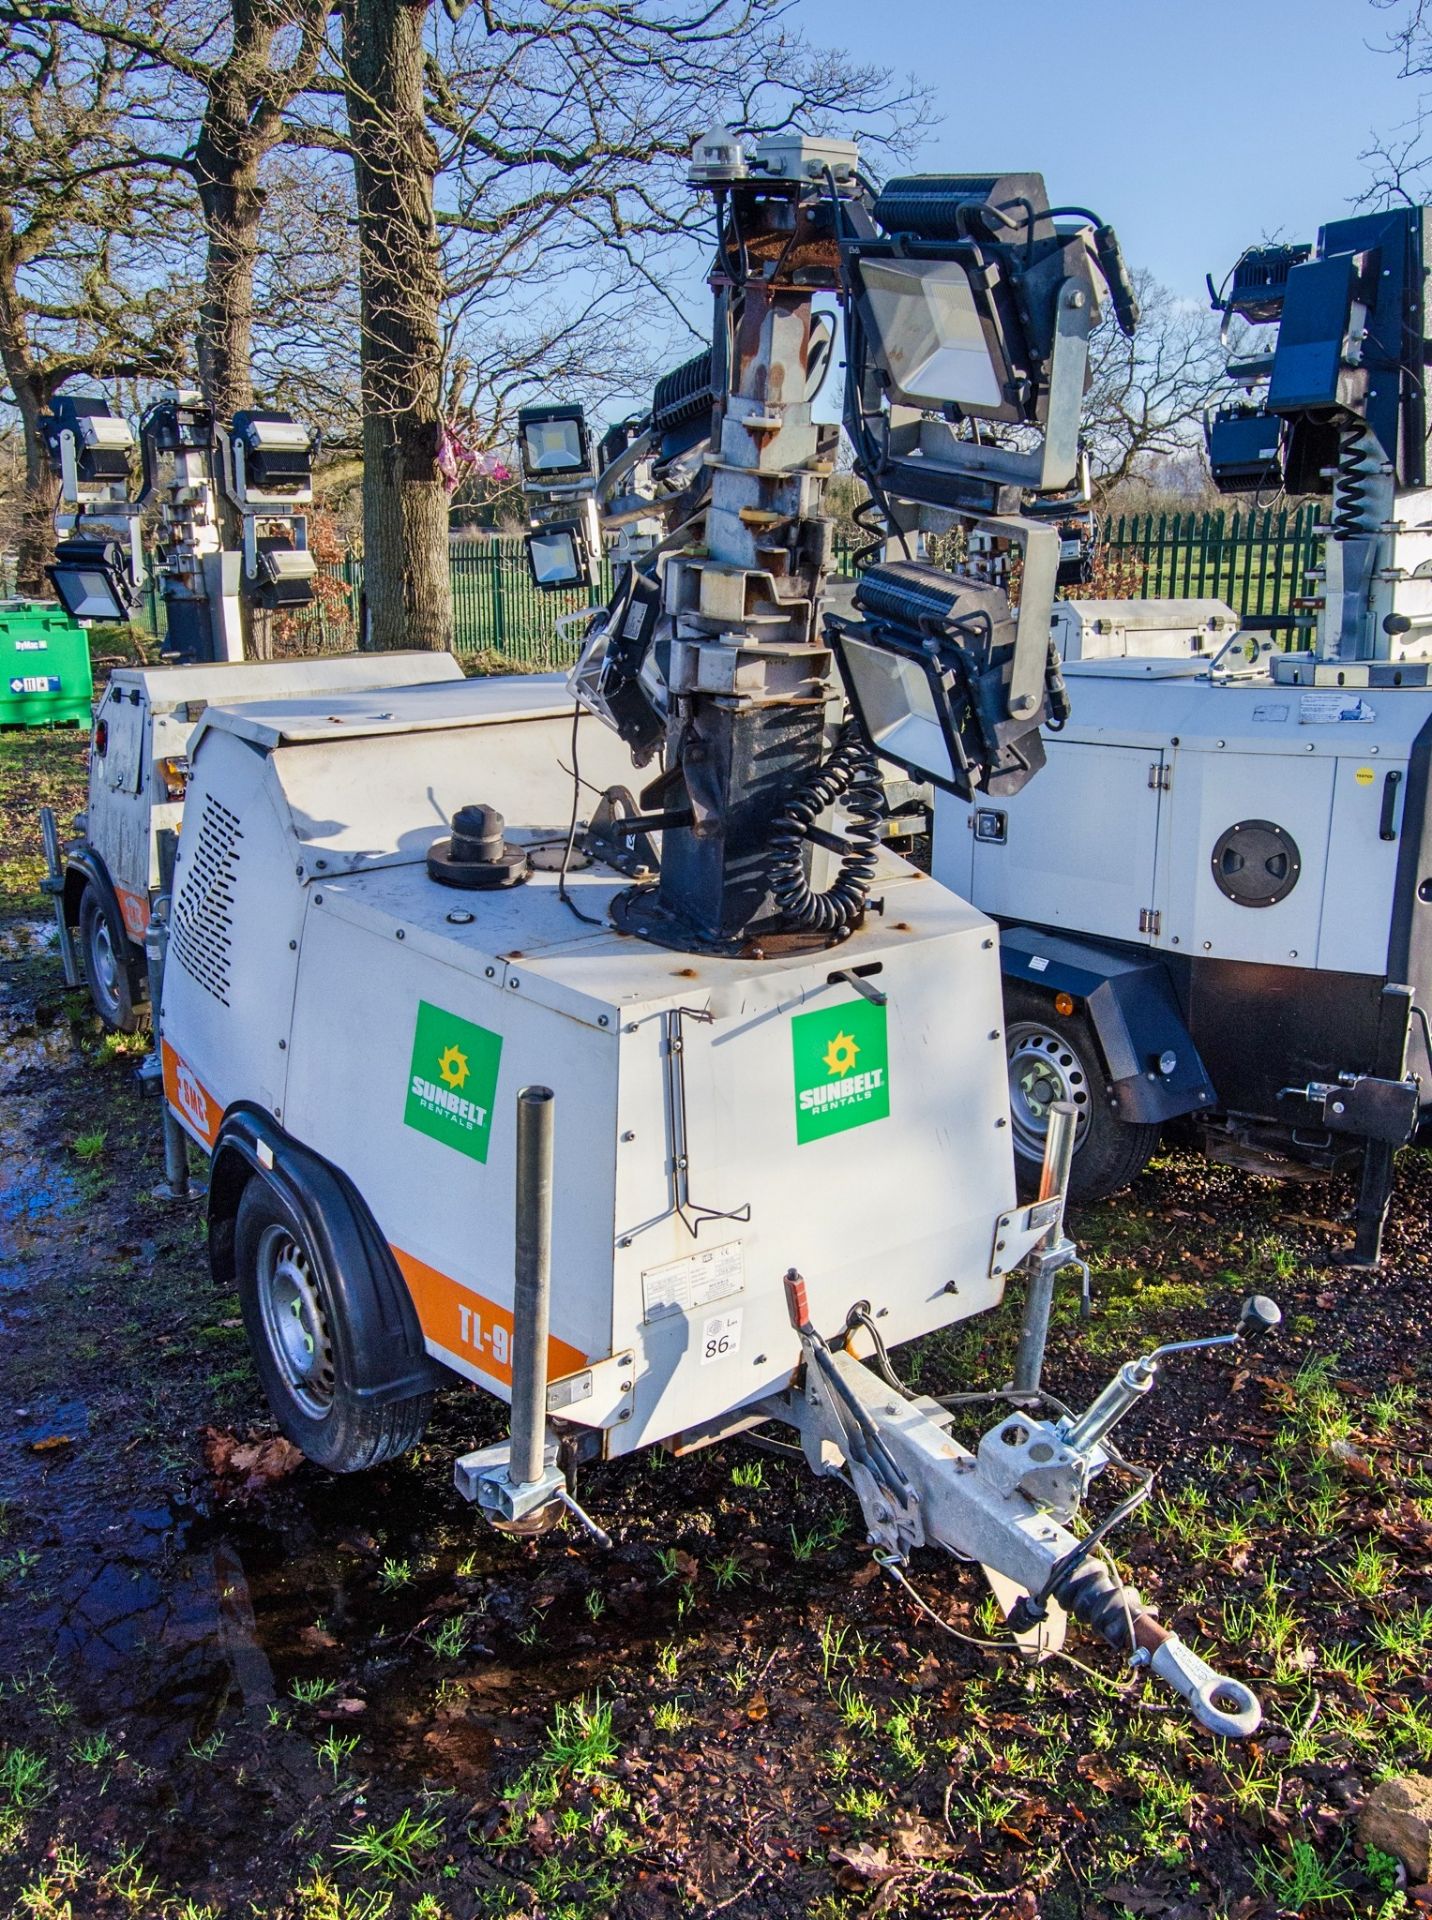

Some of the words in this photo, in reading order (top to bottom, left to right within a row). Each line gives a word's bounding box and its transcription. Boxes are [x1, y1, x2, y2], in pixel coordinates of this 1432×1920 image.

[411, 1075, 487, 1127] SUNBELT
[799, 1068, 883, 1110] SUNBELT
[812, 1090, 873, 1116] RENTALS
[420, 1099, 473, 1131] RENTALS
[458, 1303, 514, 1369] TL-9
[705, 1334, 729, 1358] 86
